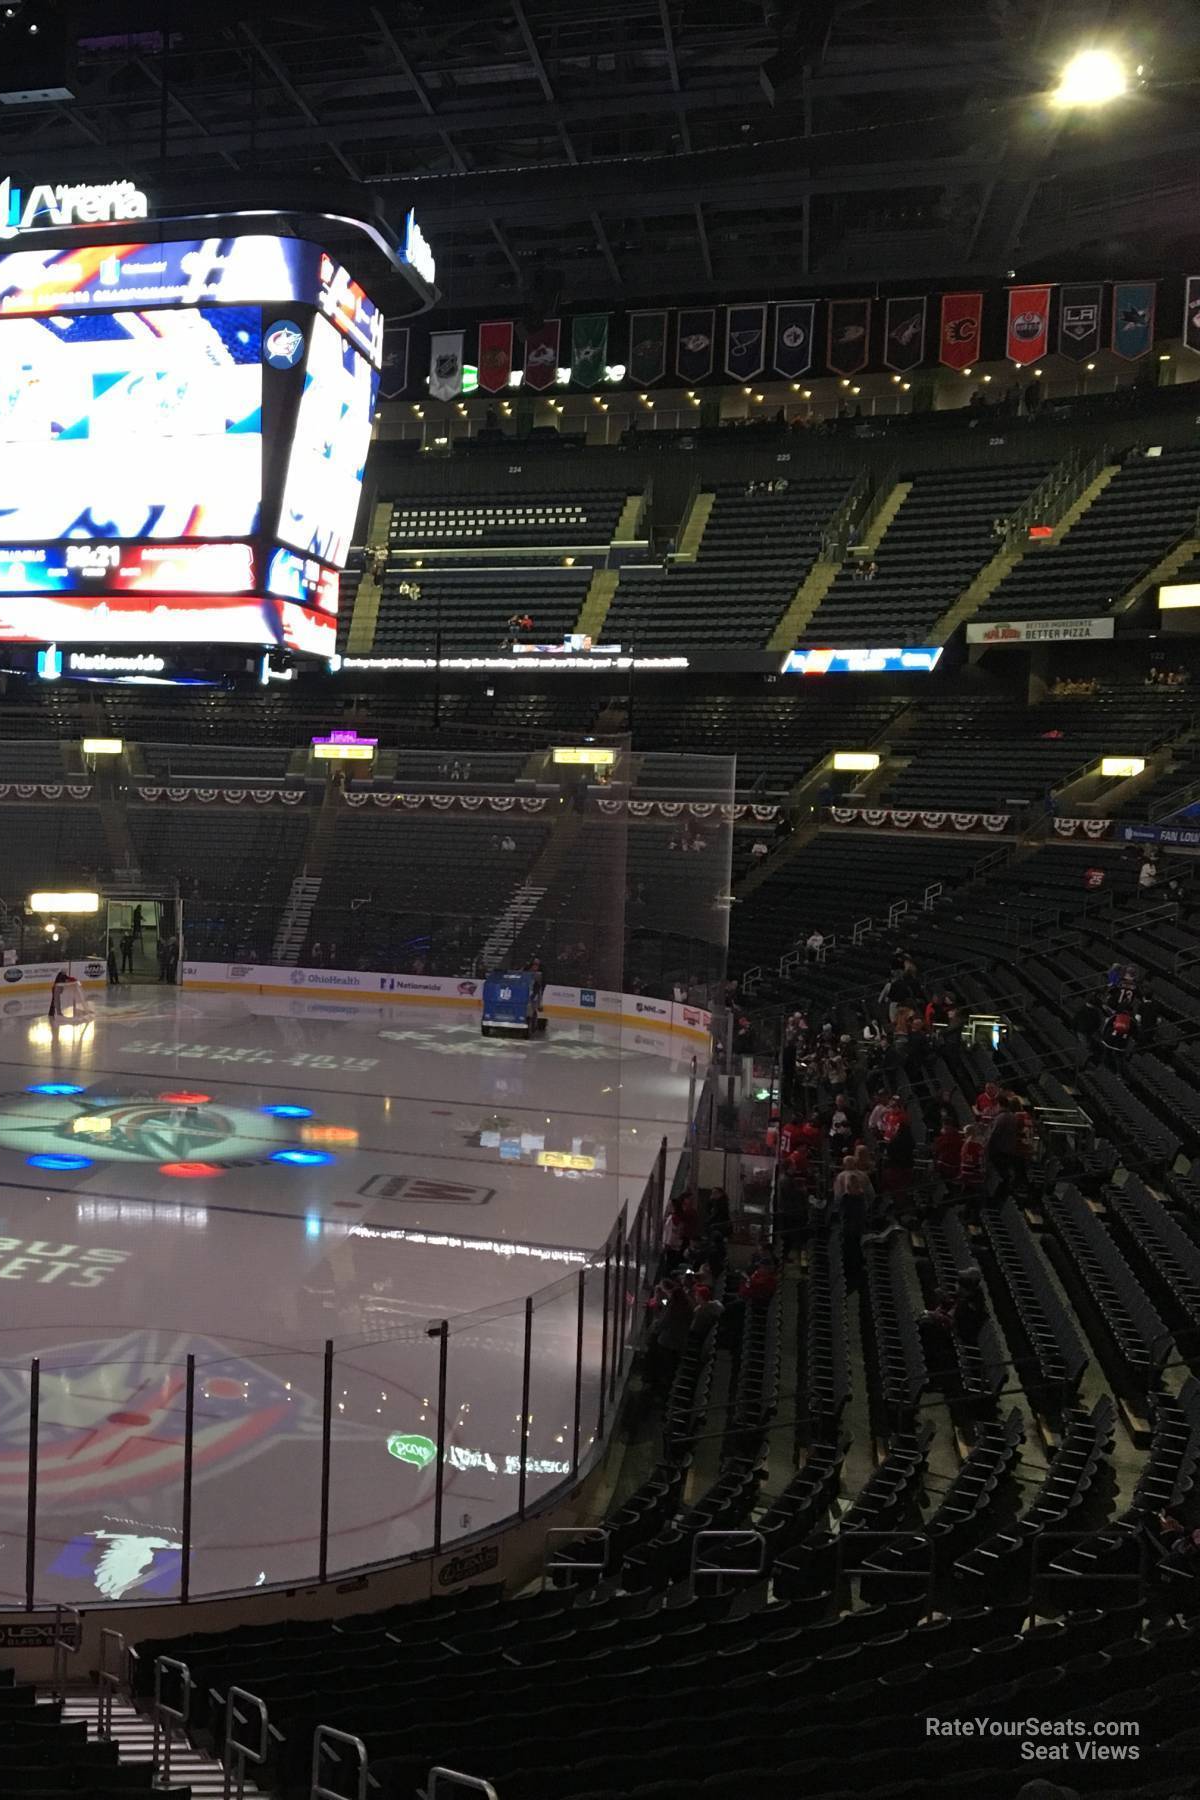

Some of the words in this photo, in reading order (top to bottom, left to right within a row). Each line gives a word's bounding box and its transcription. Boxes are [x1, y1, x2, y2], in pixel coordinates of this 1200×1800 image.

[20, 185, 147, 228] Arena
[1025, 629, 1060, 640] BETTER
[70, 653, 164, 671] Nationwide
[1160, 830, 1178, 842] FAN
[1180, 831, 1200, 843] LOU
[308, 974, 360, 985] OhioHealth
[397, 981, 442, 991] Nationwide
[7, 1626, 78, 1638] LEXUS
